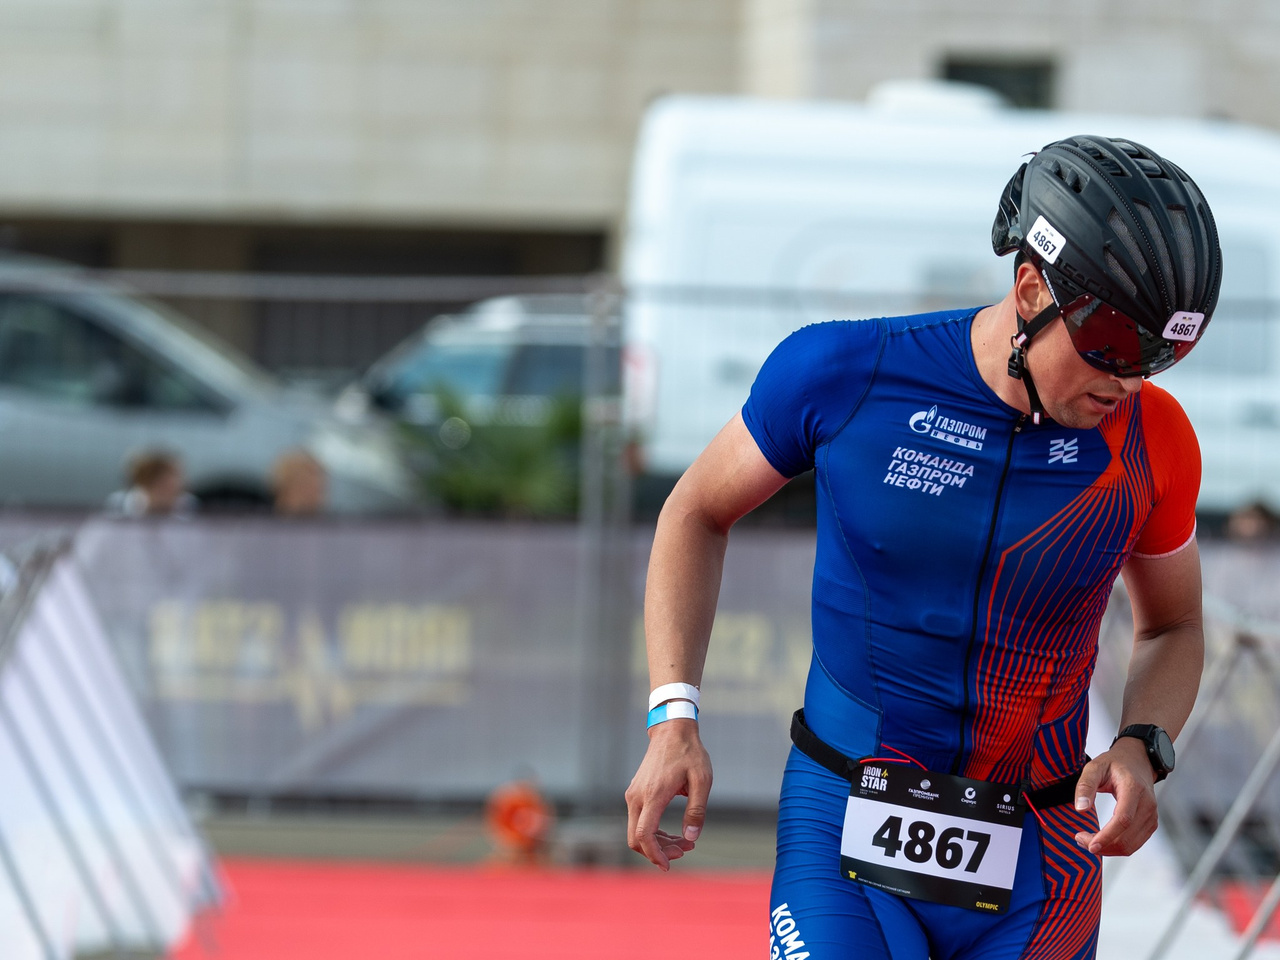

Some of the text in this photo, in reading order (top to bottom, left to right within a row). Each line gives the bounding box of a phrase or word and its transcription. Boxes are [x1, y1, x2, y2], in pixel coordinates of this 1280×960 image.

[1033, 230, 1057, 256] 4867
[1170, 323, 1197, 336] 4867
[935, 415, 988, 441] ГАЗПРОМ
[932, 430, 983, 450] НЕФТЬ
[892, 447, 975, 477] КОМАНДА
[883, 472, 945, 496] НЕФТИ
[887, 459, 967, 489] ГАЗПРОМ
[861, 775, 888, 791] STAR
[863, 766, 882, 778] IRON
[996, 803, 1015, 811] SIRIUS
[871, 815, 992, 874] 4867
[975, 901, 999, 911] OLYMPIC
